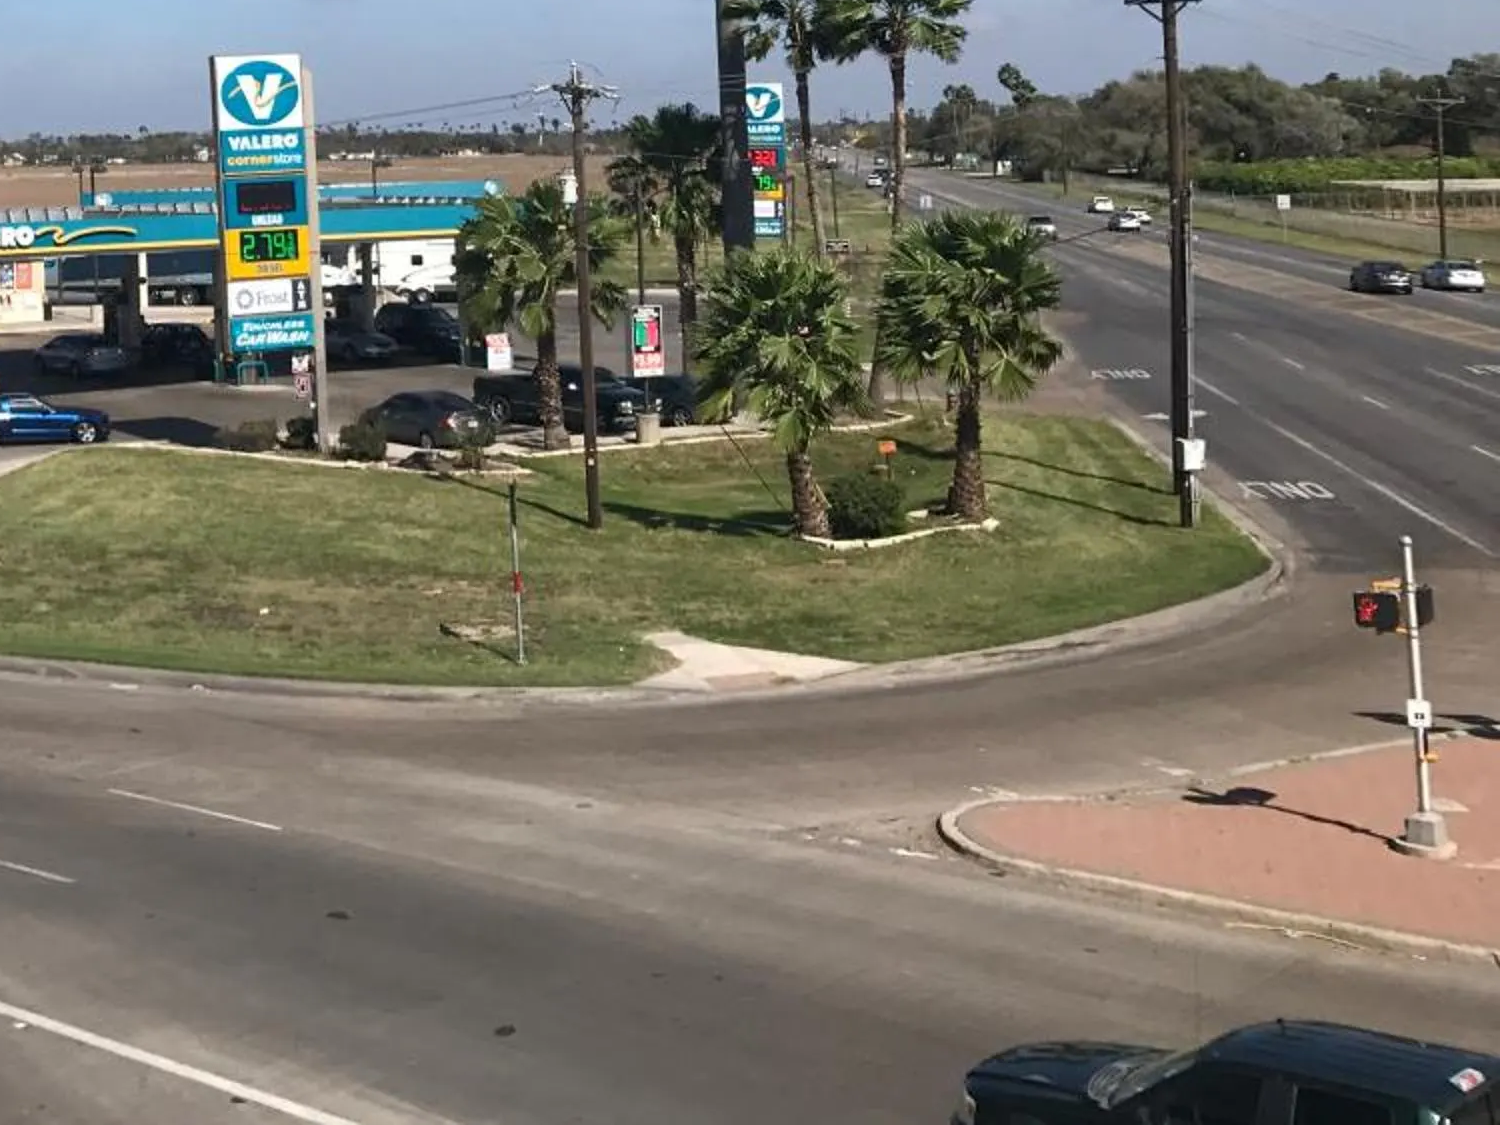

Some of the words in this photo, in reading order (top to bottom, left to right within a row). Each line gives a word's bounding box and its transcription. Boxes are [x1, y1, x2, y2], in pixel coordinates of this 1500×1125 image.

[747, 124, 781, 134] ALERO
[228, 133, 299, 150] VALERO
[228, 153, 302, 166] cornerstore
[257, 290, 289, 306] Frost
[243, 320, 305, 331] TOUCHLESS
[1237, 481, 1337, 500] ONLY
